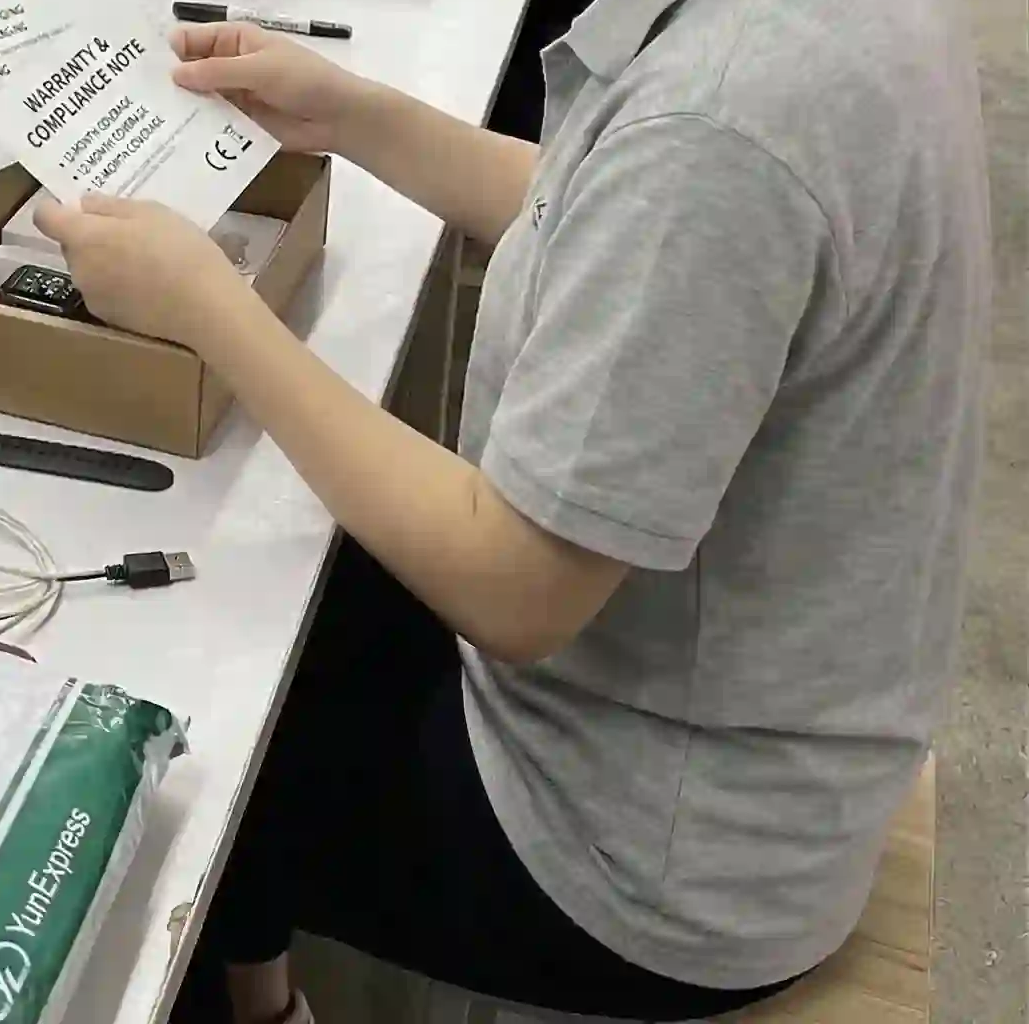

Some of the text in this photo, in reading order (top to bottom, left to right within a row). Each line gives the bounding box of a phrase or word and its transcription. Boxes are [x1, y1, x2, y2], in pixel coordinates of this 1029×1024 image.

[22, 43, 98, 113] WARRANTY
[93, 37, 110, 53] &
[27, 68, 113, 148] COMPLIANCE
[106, 38, 146, 77] NOTE
[76, 163, 91, 176] 12
[91, 175, 107, 189] 12
[5, 807, 91, 937] YunExpress
